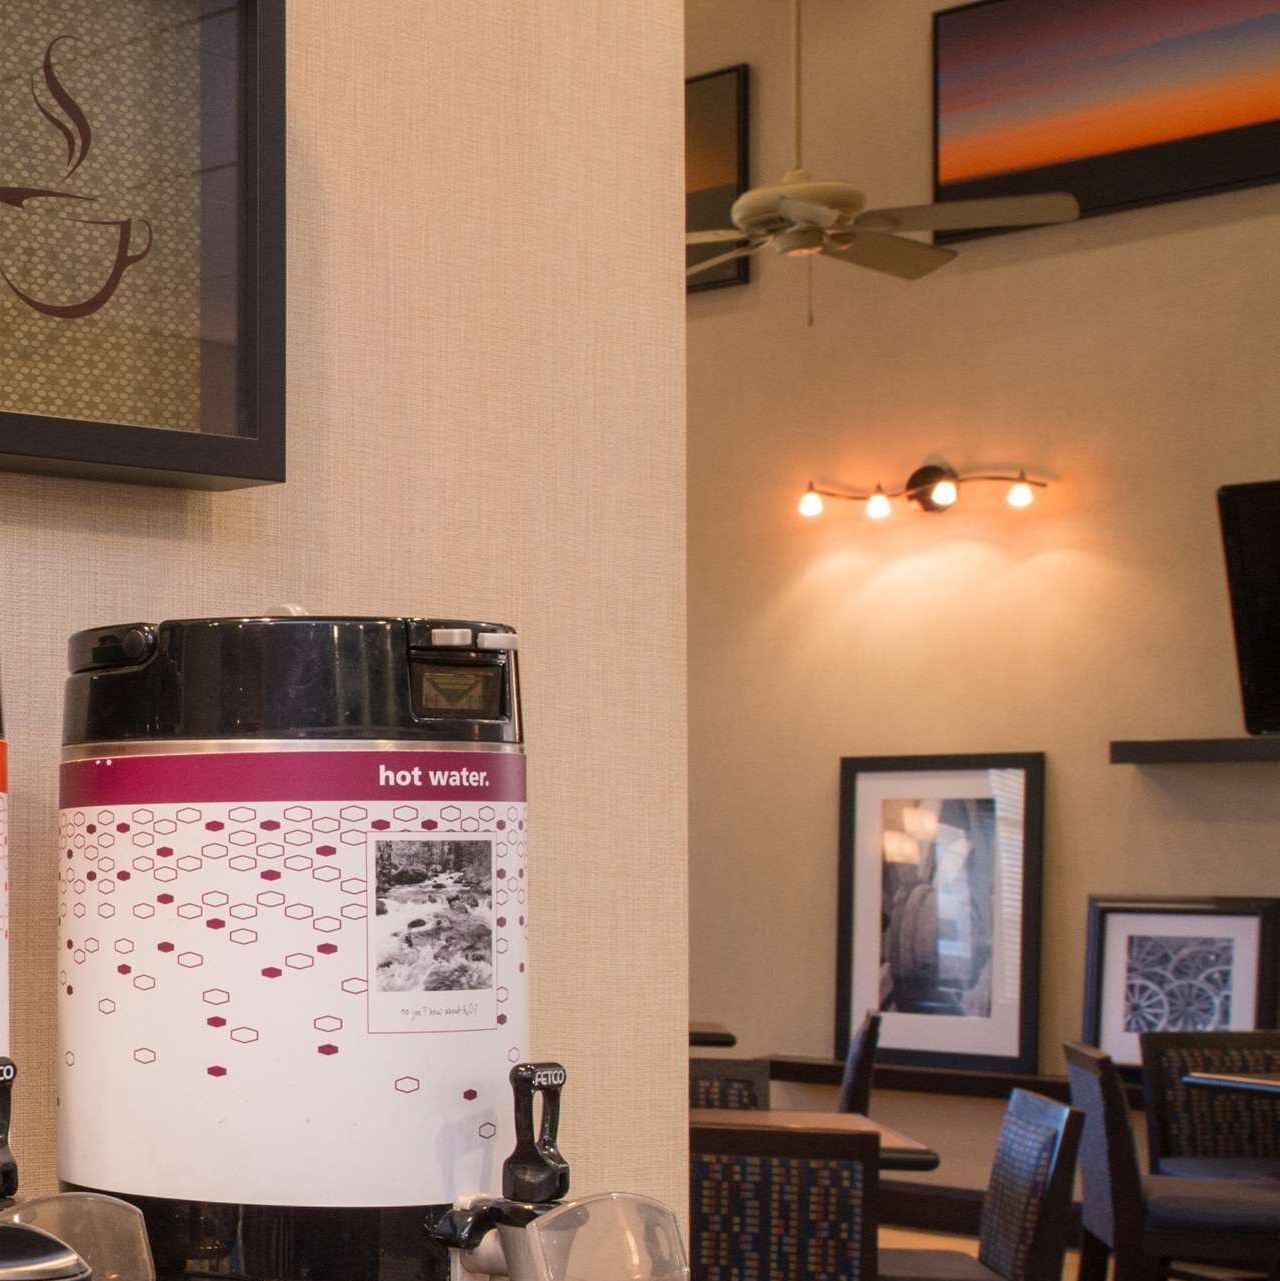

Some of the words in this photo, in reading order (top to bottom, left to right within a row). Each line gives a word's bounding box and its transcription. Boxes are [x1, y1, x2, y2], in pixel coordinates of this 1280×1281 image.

[379, 764, 422, 787] hot
[428, 767, 490, 787] water.
[535, 1070, 565, 1086] FETCO
